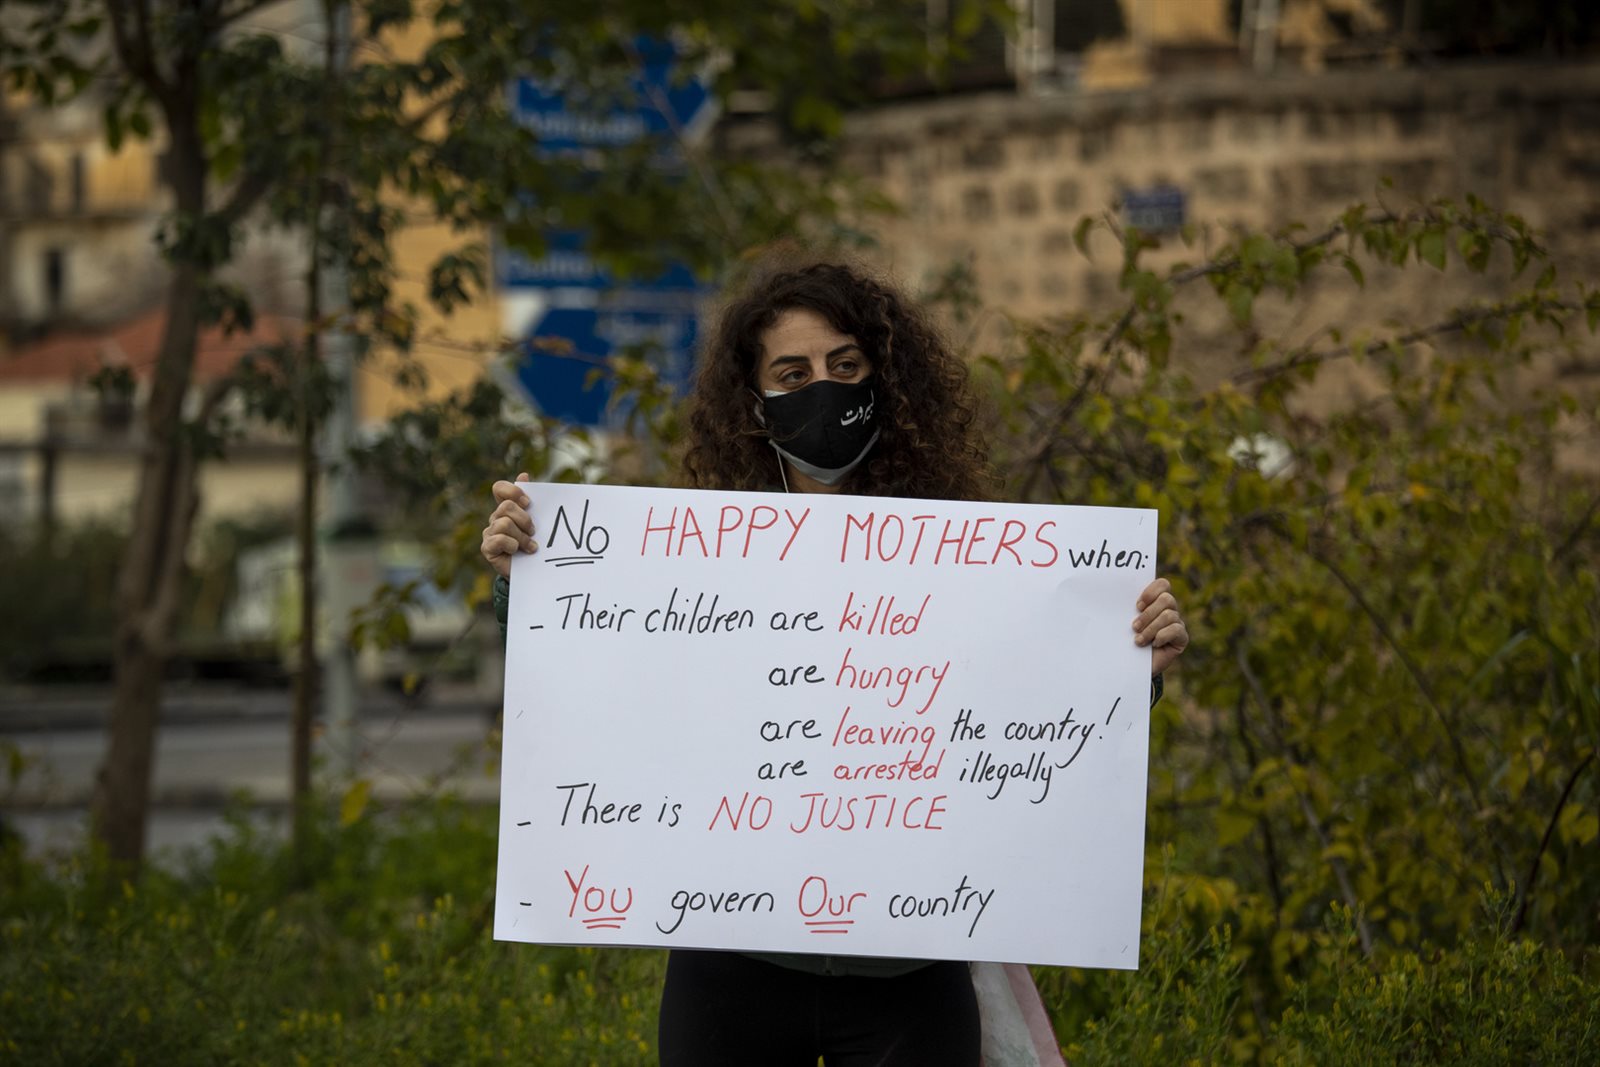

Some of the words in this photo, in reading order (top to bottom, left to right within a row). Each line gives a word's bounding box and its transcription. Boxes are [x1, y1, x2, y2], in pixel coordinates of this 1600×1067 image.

[546, 499, 610, 555] No
[641, 506, 811, 561] HAPPY
[840, 512, 1059, 568] MOTHERS
[1068, 539, 1150, 570] when:
[556, 592, 636, 632] Their
[644, 587, 754, 634] children
[769, 610, 824, 631] are
[838, 592, 931, 635] killed
[768, 664, 825, 686] are
[835, 647, 951, 715] hungry
[759, 719, 822, 742] are
[832, 706, 936, 767] leaving
[949, 708, 987, 743] the
[1004, 697, 1121, 769] country!
[757, 760, 808, 780] are
[833, 749, 946, 781] arrested
[958, 750, 1053, 804] illegally
[556, 783, 643, 826] There
[657, 796, 682, 827] is
[708, 792, 773, 831] NO
[789, 792, 948, 834] JUSTICE
[656, 890, 775, 934] govern
[798, 876, 868, 917] Our
[888, 875, 995, 938] country
